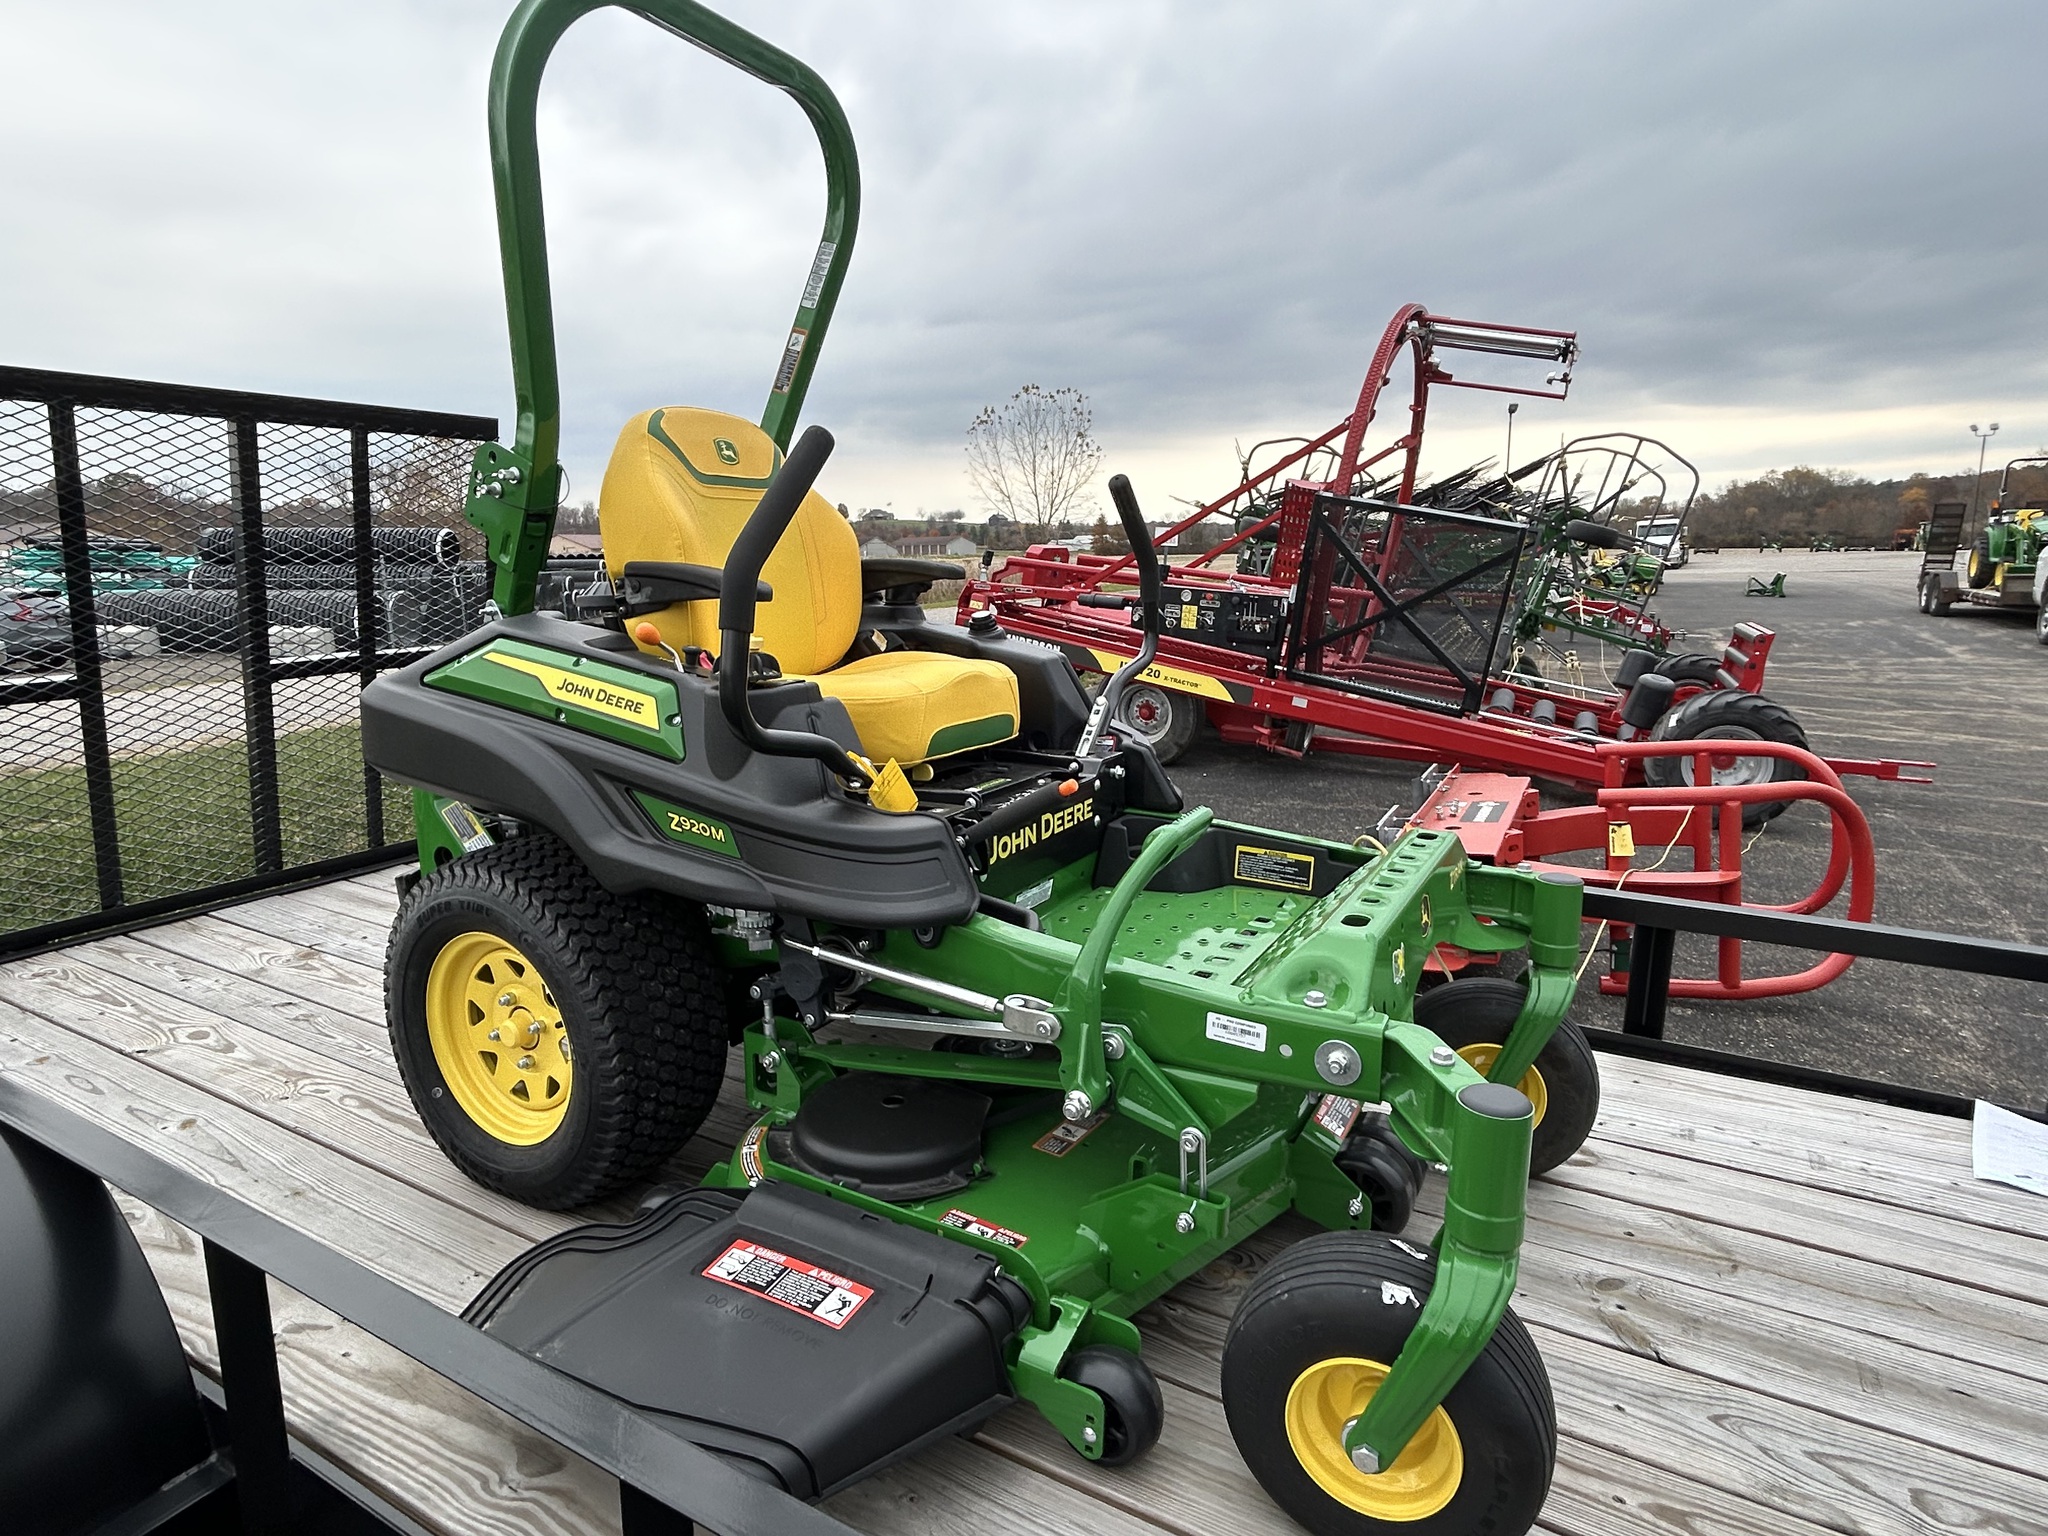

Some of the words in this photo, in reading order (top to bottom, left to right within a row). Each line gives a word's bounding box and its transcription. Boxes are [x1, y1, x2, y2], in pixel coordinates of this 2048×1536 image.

[557, 678, 595, 699] JOHN
[595, 688, 645, 714] DEERE
[666, 811, 726, 842] Z920M
[989, 822, 1037, 865] JOHN
[1041, 798, 1093, 840] DEERE
[754, 1244, 787, 1263] DANGER
[816, 1269, 854, 1290] PELIGRO
